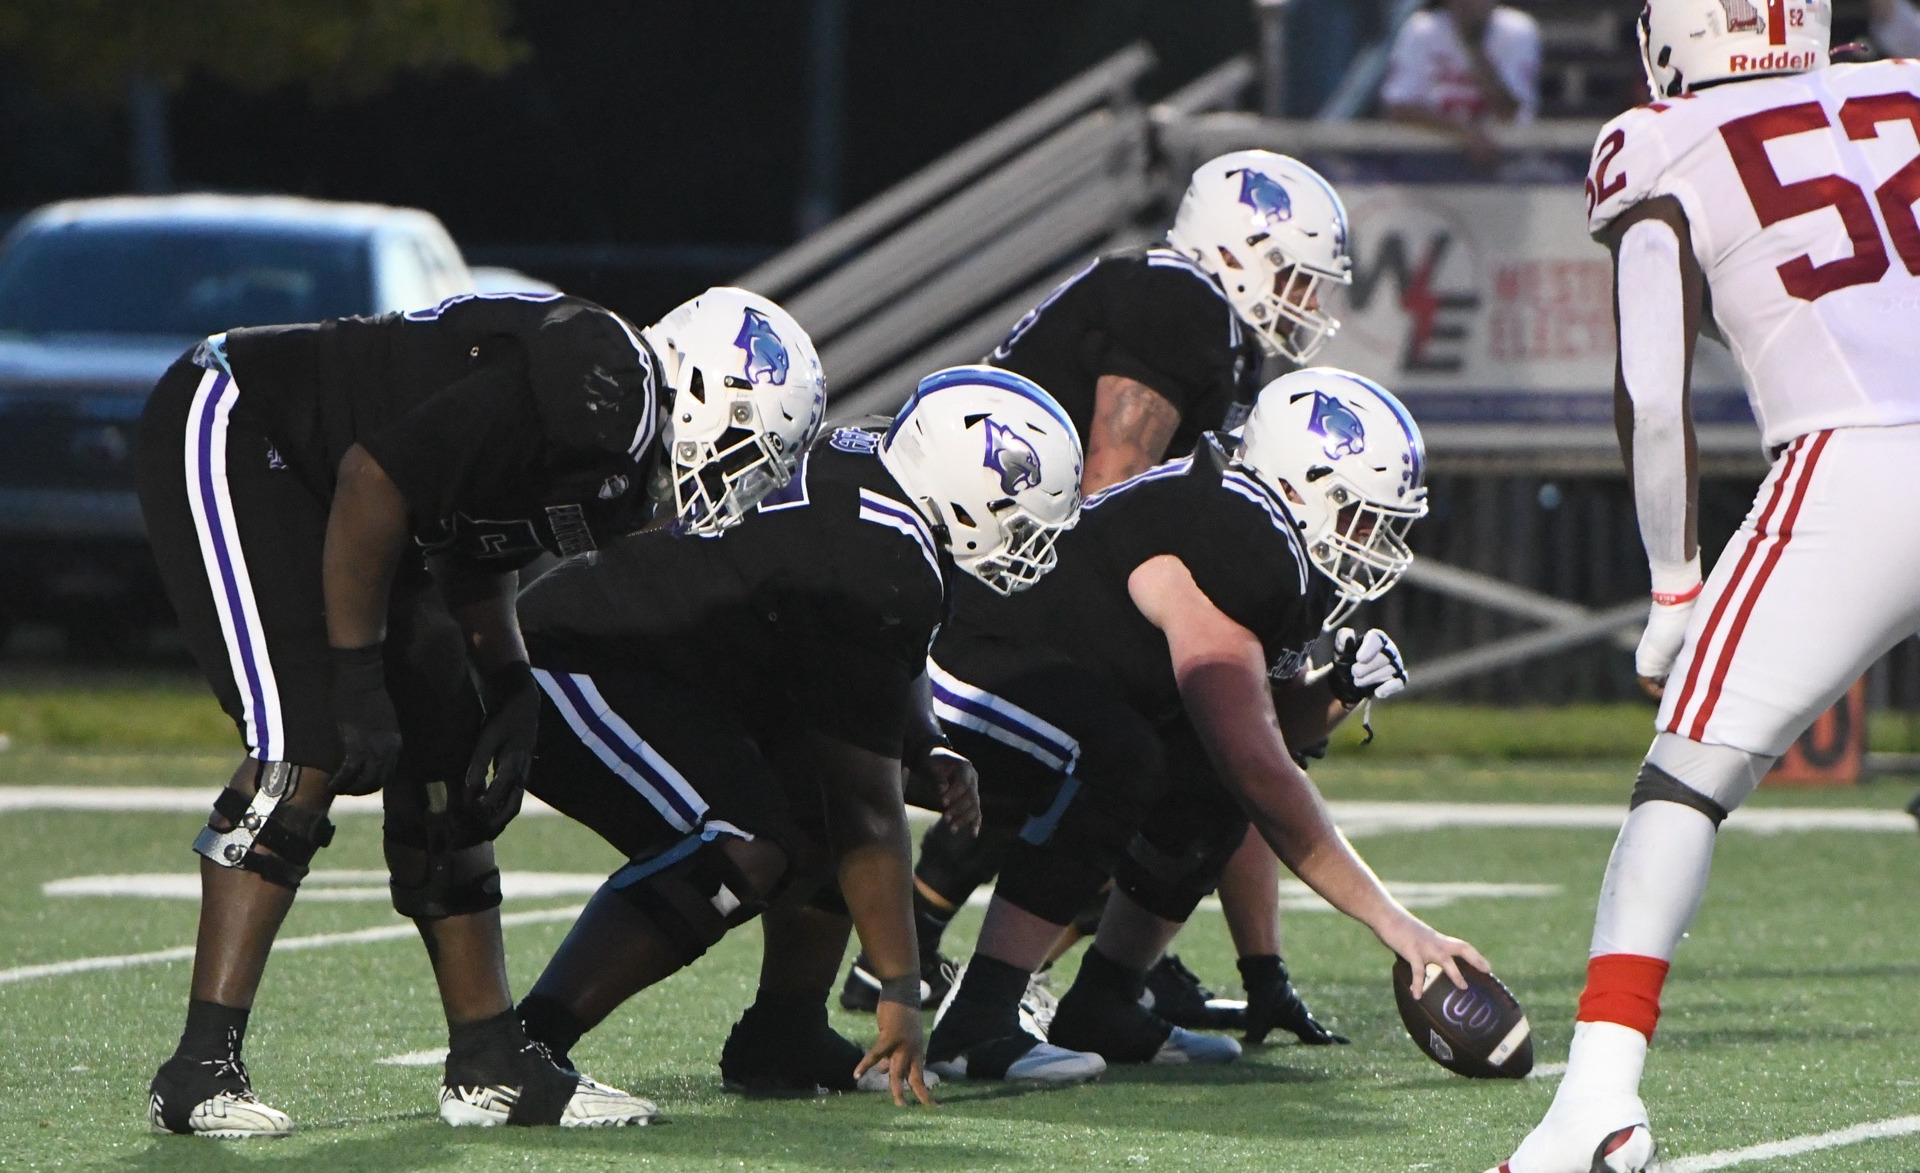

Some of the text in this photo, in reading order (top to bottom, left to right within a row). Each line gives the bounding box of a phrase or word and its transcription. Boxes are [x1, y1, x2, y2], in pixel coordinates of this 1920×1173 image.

[1789, 8, 1804, 27] 52
[1730, 51, 1816, 73] Riddell
[1718, 91, 1920, 302] 52
